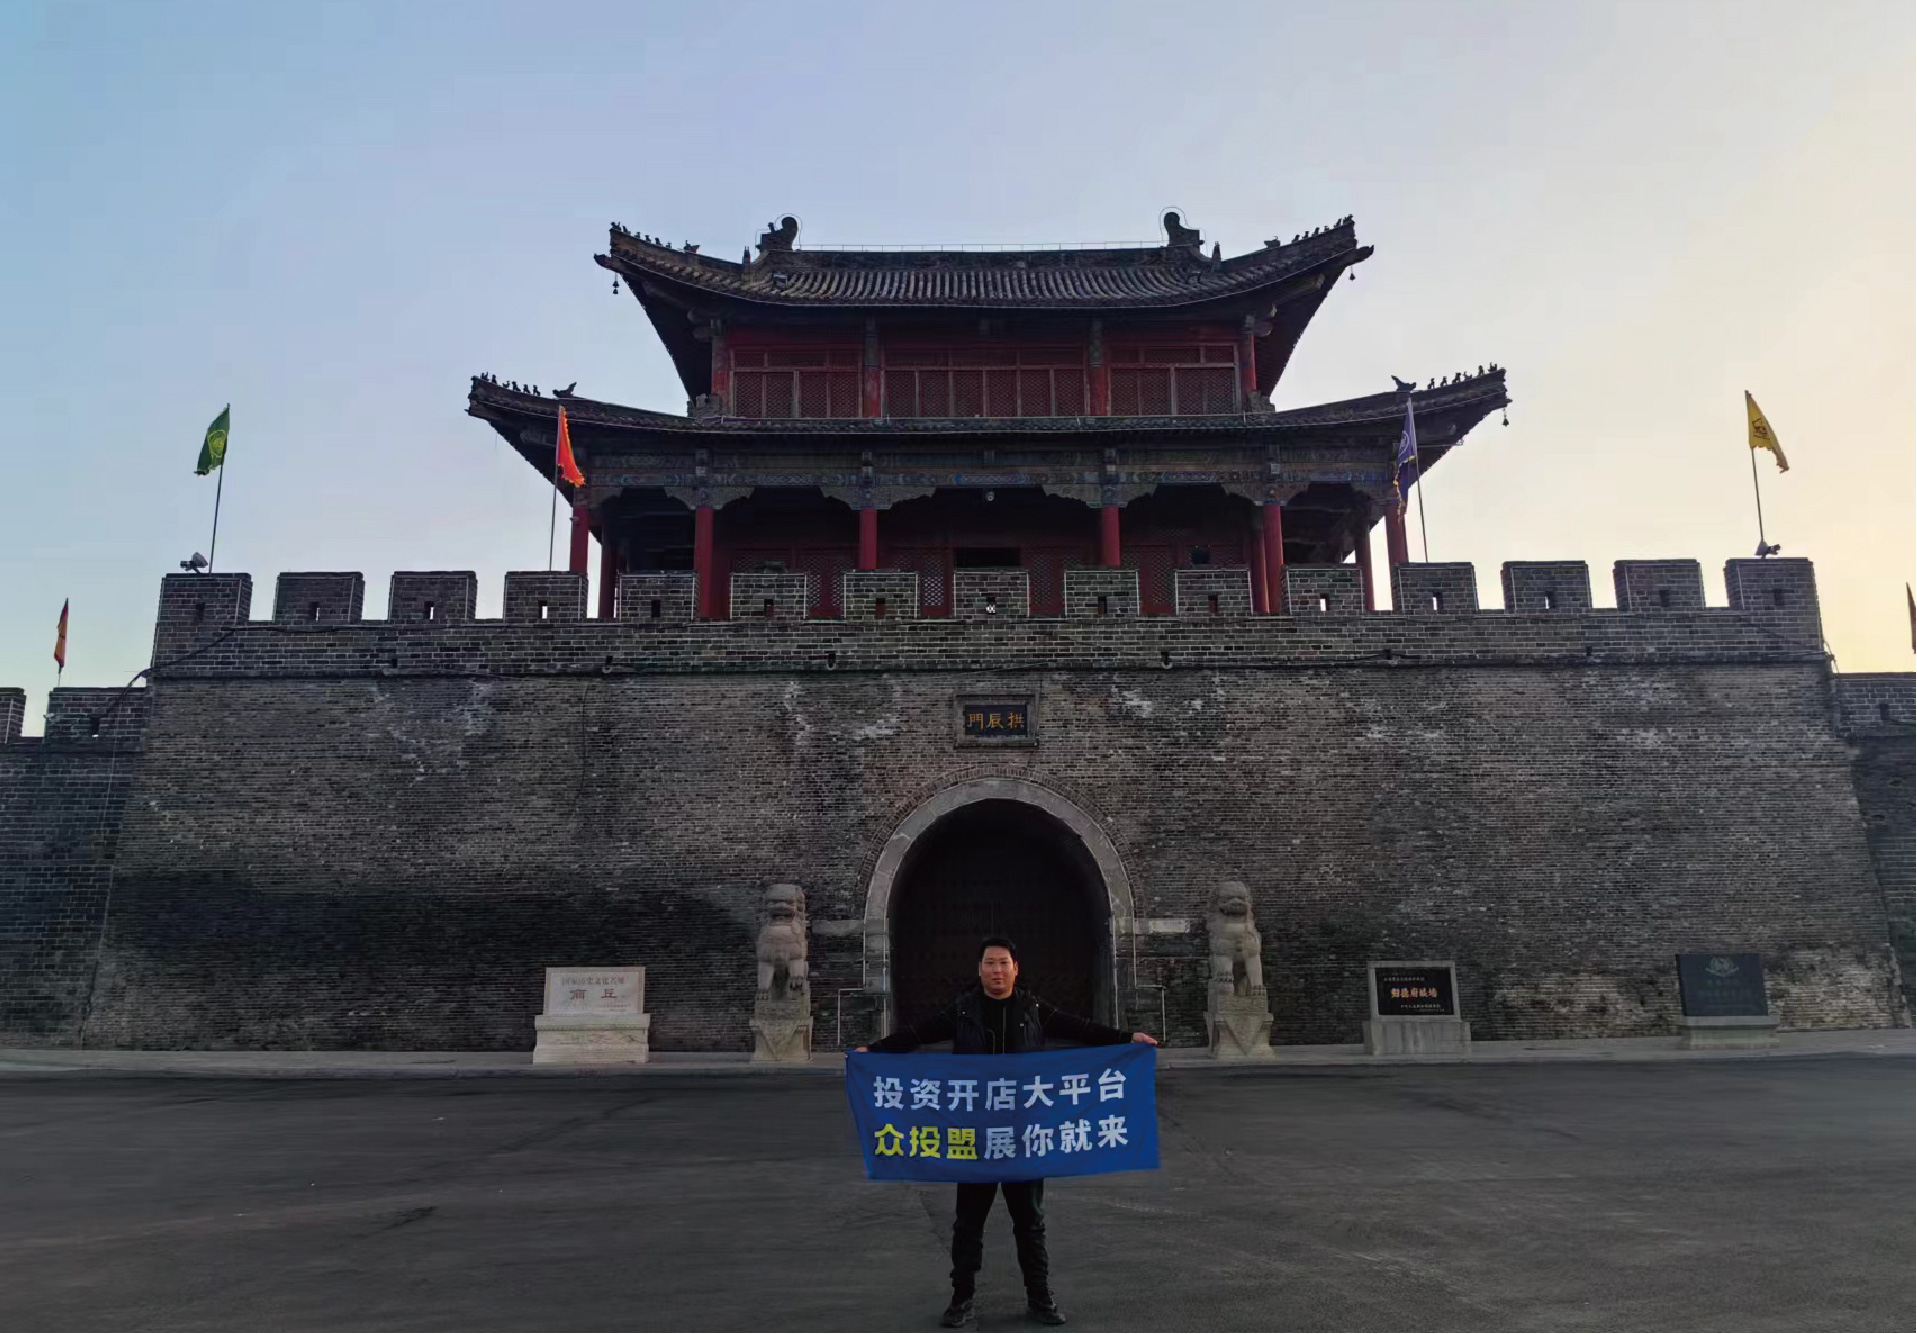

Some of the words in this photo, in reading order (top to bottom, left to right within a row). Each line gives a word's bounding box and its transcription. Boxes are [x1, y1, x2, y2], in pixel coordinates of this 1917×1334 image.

[873, 1068, 1128, 1112] 投资开店大平台
[873, 1114, 1129, 1160] 众投盟展你就来
